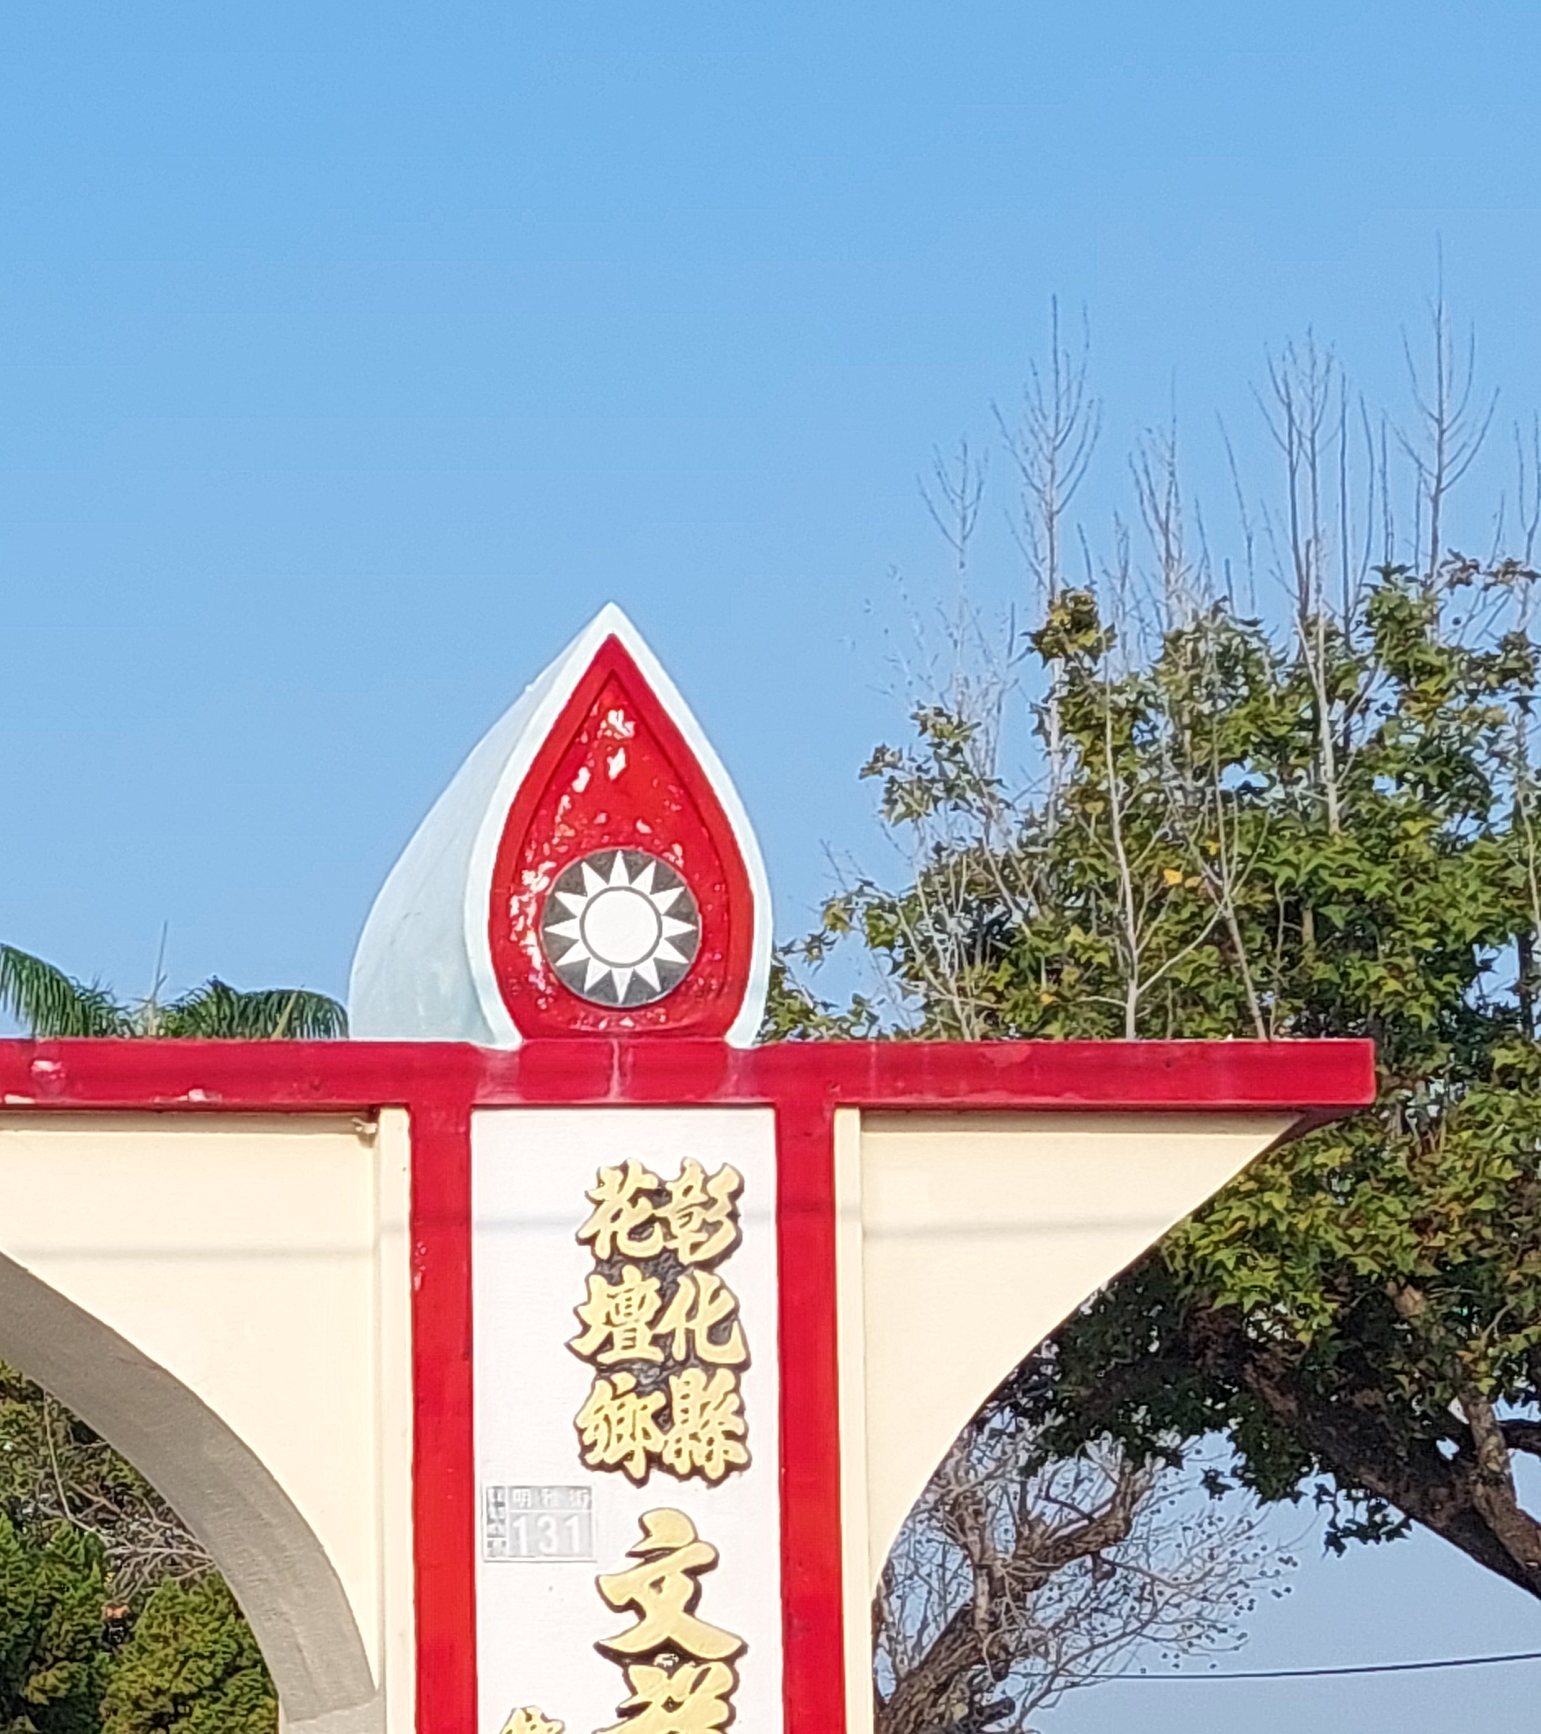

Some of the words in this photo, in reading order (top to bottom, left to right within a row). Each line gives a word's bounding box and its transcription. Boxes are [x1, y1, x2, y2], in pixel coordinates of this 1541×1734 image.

[566, 1157, 668, 1488] 花壇鄉
[659, 1156, 753, 1487] 彰化縣
[512, 1514, 582, 1557] 131
